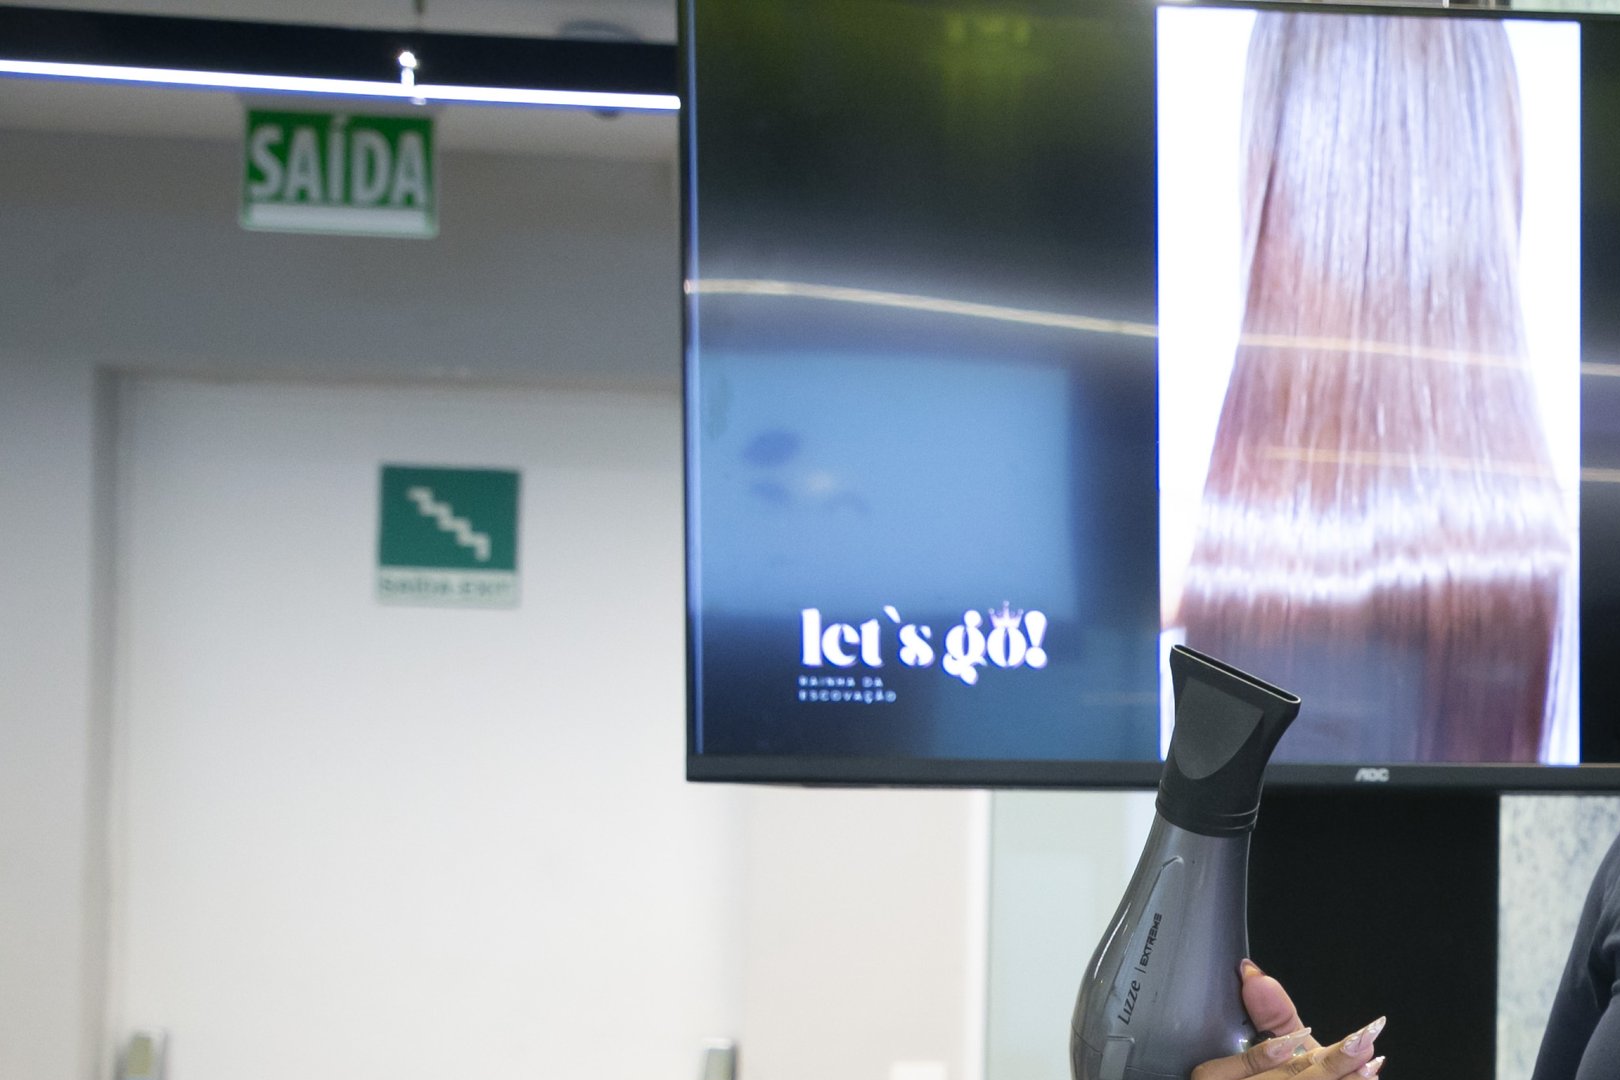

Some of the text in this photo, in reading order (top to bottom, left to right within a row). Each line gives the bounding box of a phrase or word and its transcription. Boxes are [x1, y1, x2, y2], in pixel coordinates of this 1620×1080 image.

[250, 113, 428, 205] SAÍDA
[862, 676, 884, 688] DA
[799, 689, 897, 704] ESCOVAÇÃO
[1355, 767, 1390, 782] AOC
[1140, 912, 1163, 967] EXTREME
